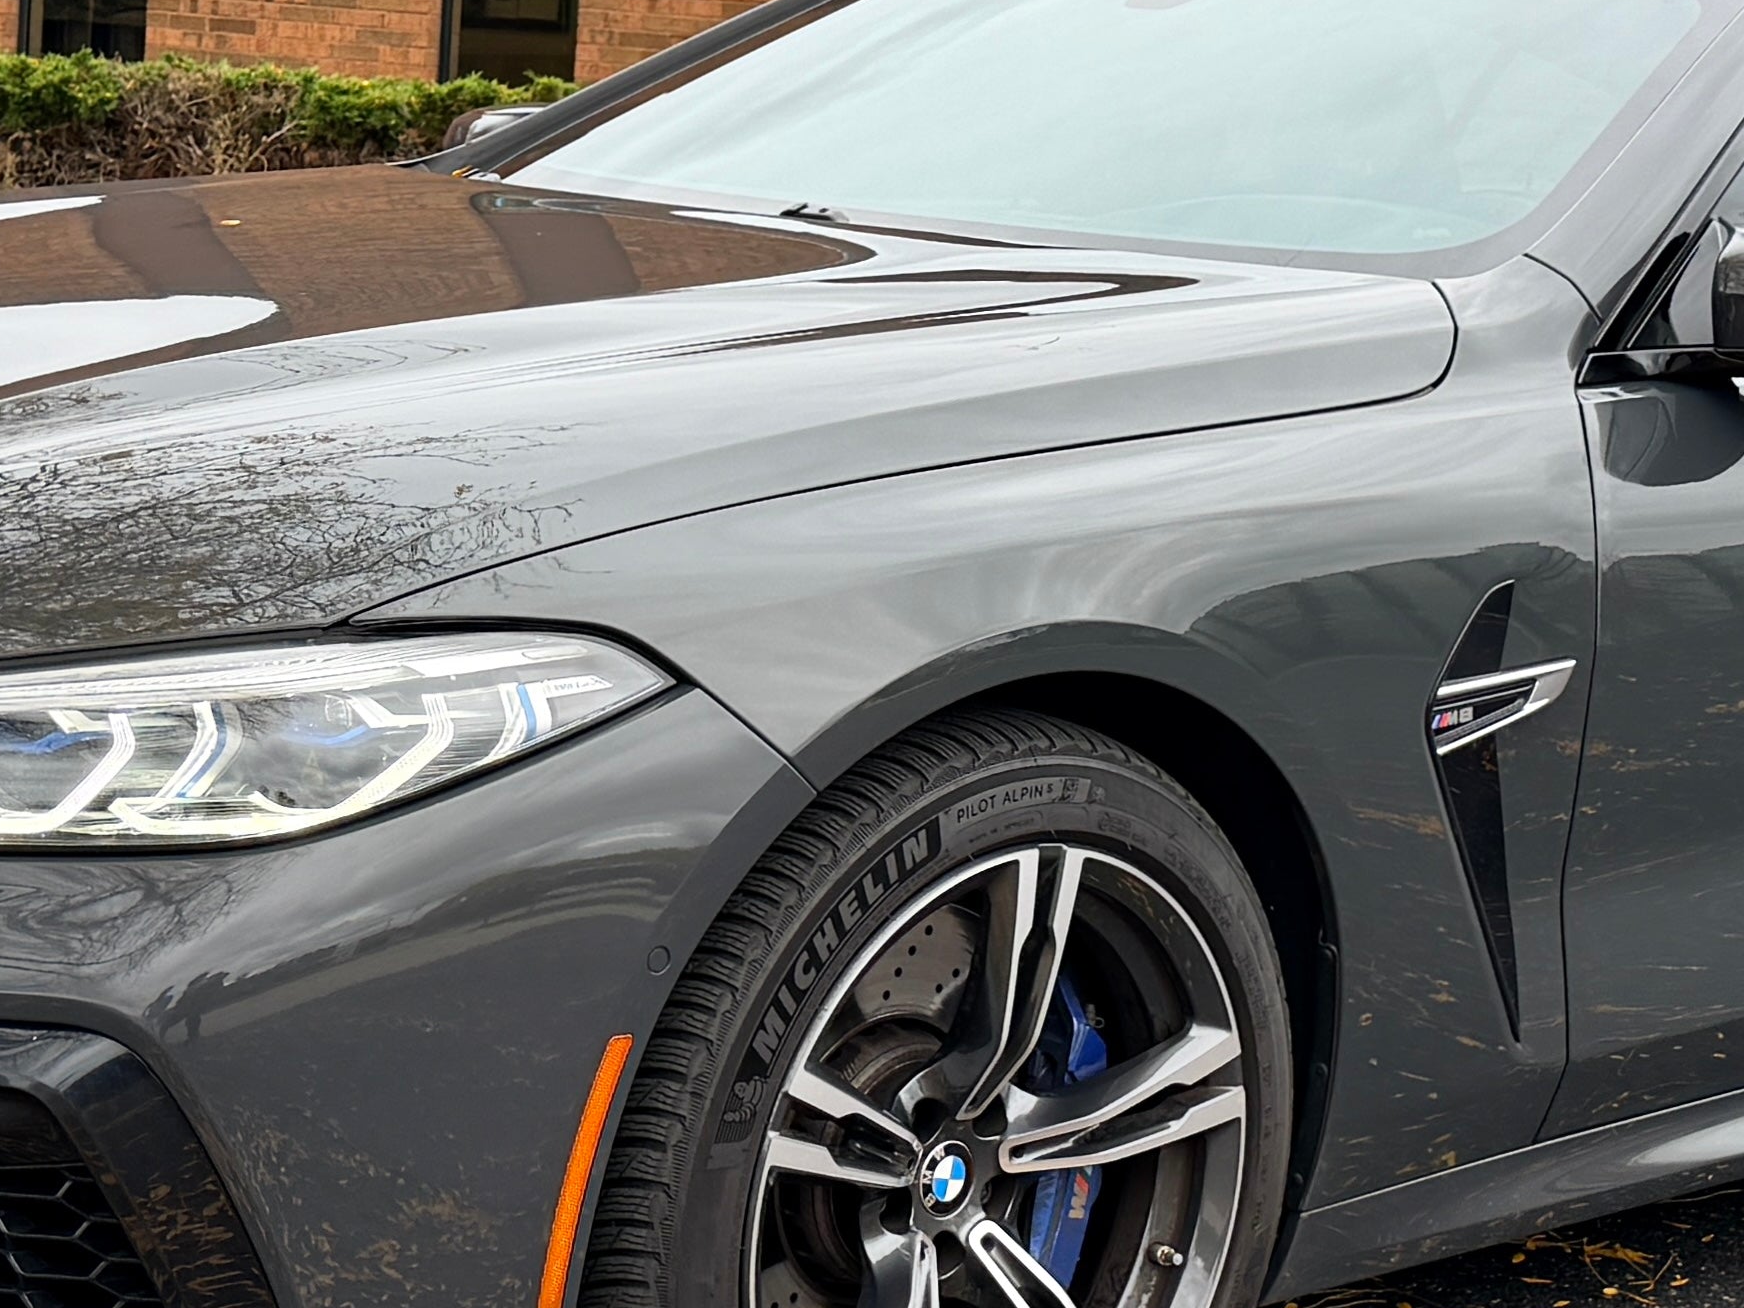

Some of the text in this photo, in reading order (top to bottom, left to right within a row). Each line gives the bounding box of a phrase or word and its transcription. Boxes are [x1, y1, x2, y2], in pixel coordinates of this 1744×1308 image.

[956, 794, 997, 824] PILOT
[1002, 784, 1044, 805] ALPIN
[752, 827, 929, 1065] MICHELIN
